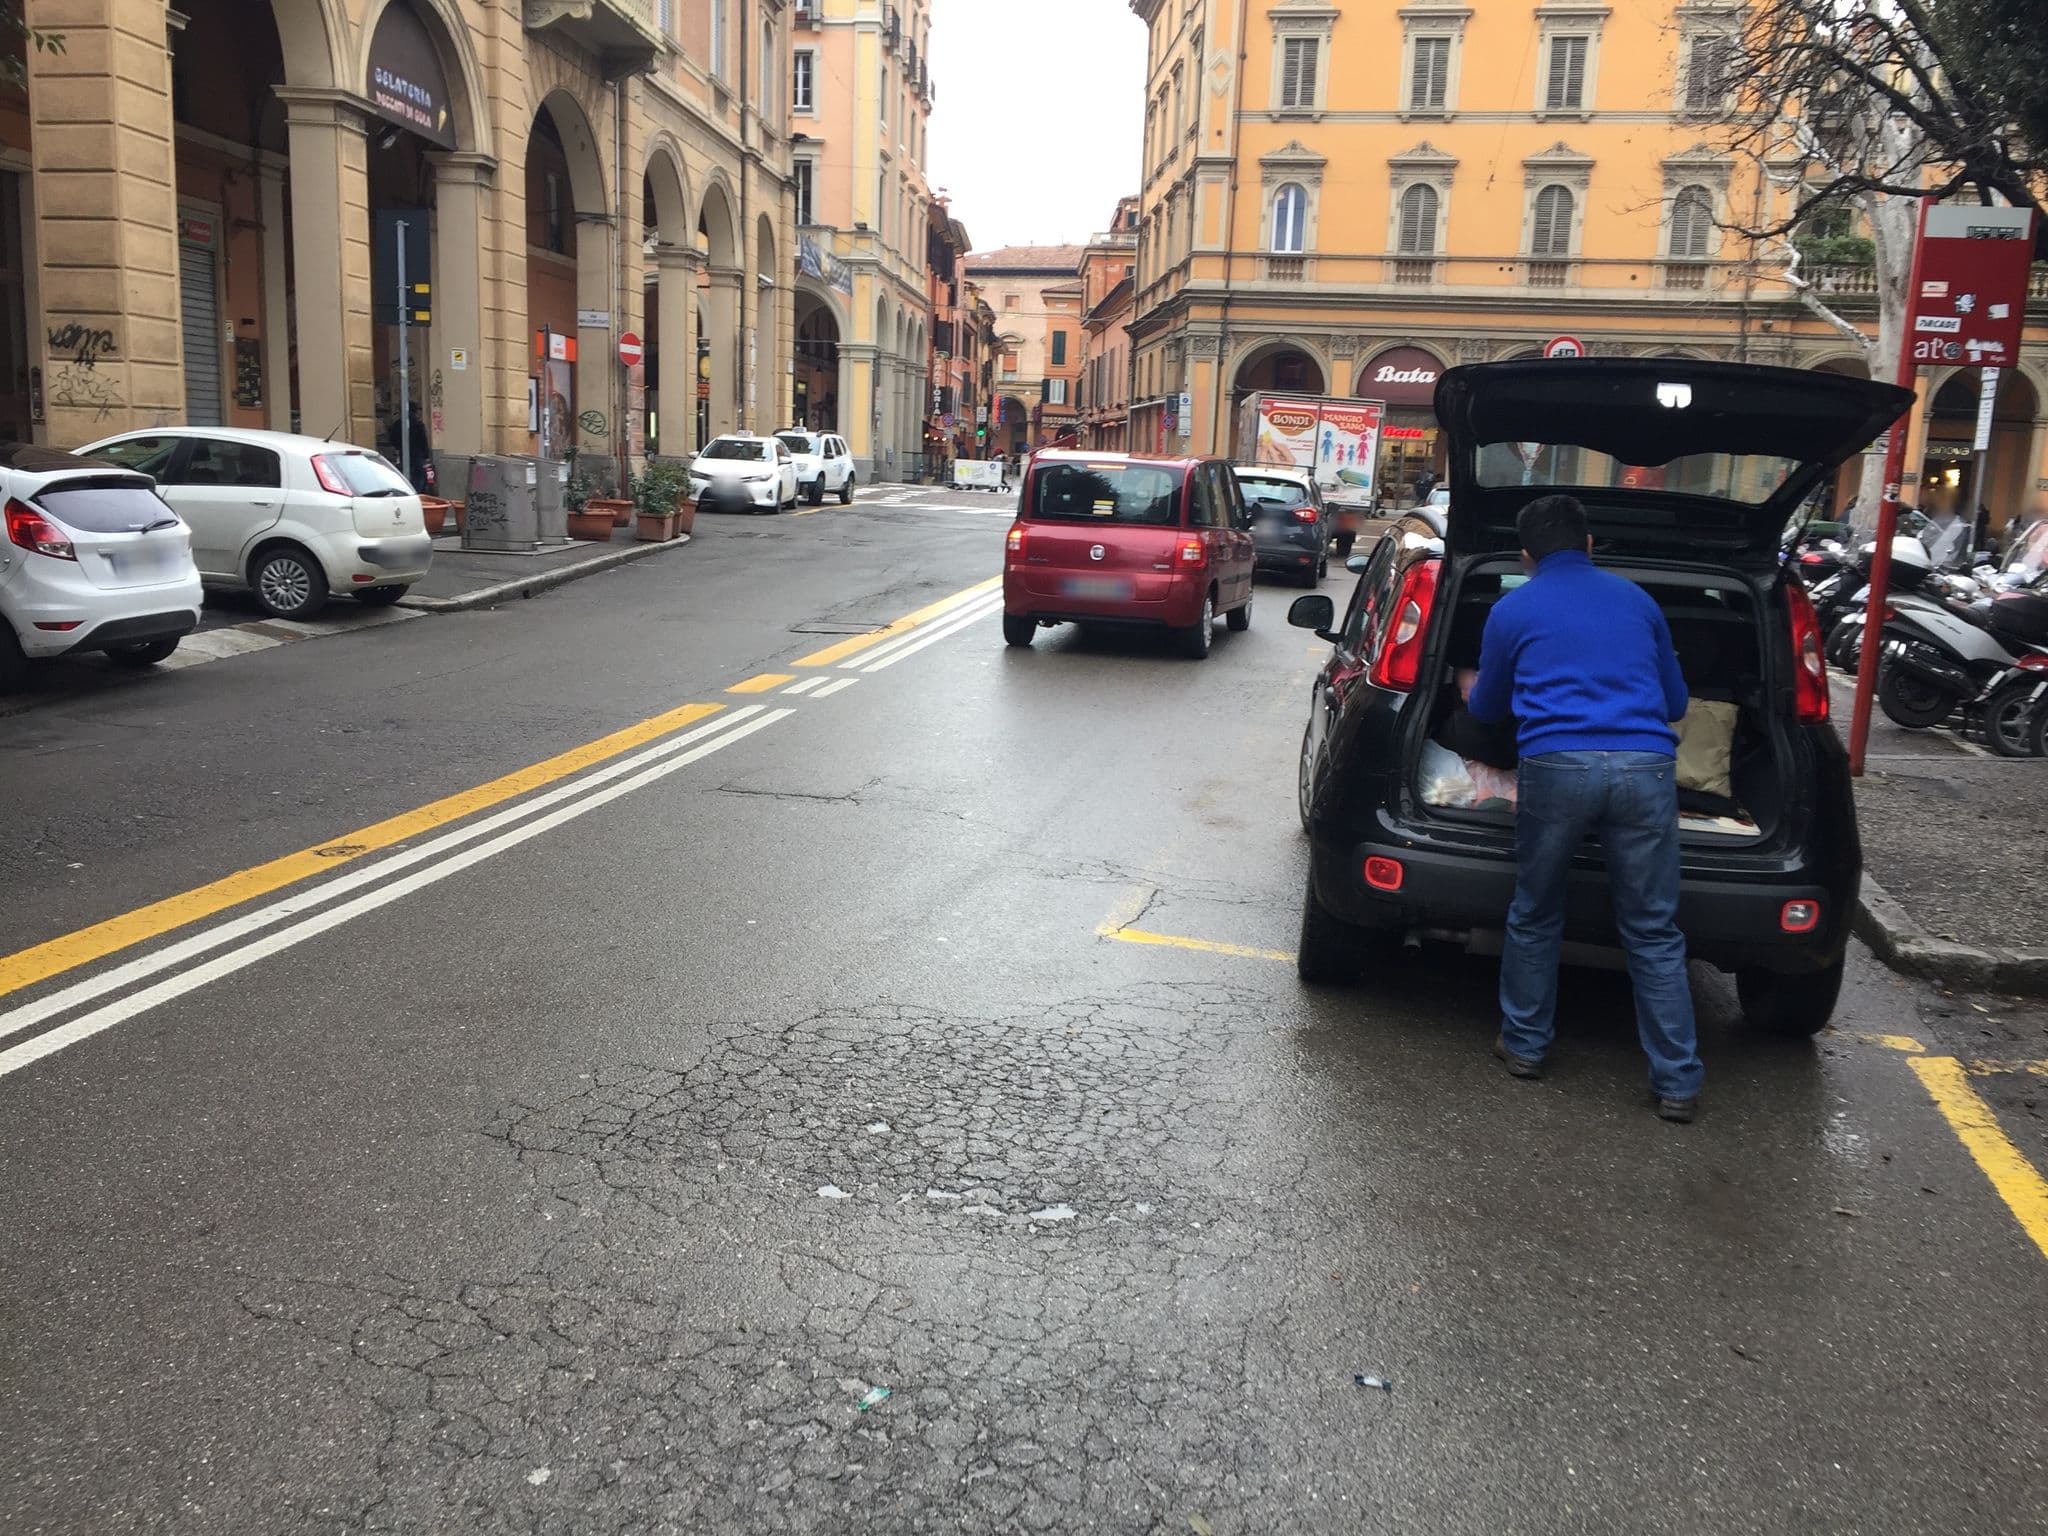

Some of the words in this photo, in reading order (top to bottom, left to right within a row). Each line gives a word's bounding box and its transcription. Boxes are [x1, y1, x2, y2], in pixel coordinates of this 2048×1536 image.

[375, 67, 432, 108] GELATERIA
[1374, 366, 1437, 383] Bata
[1272, 414, 1310, 426] BONDI
[1323, 413, 1363, 423] MANGIO
[1340, 422, 1366, 431] SANO
[1382, 425, 1425, 438] Bata
